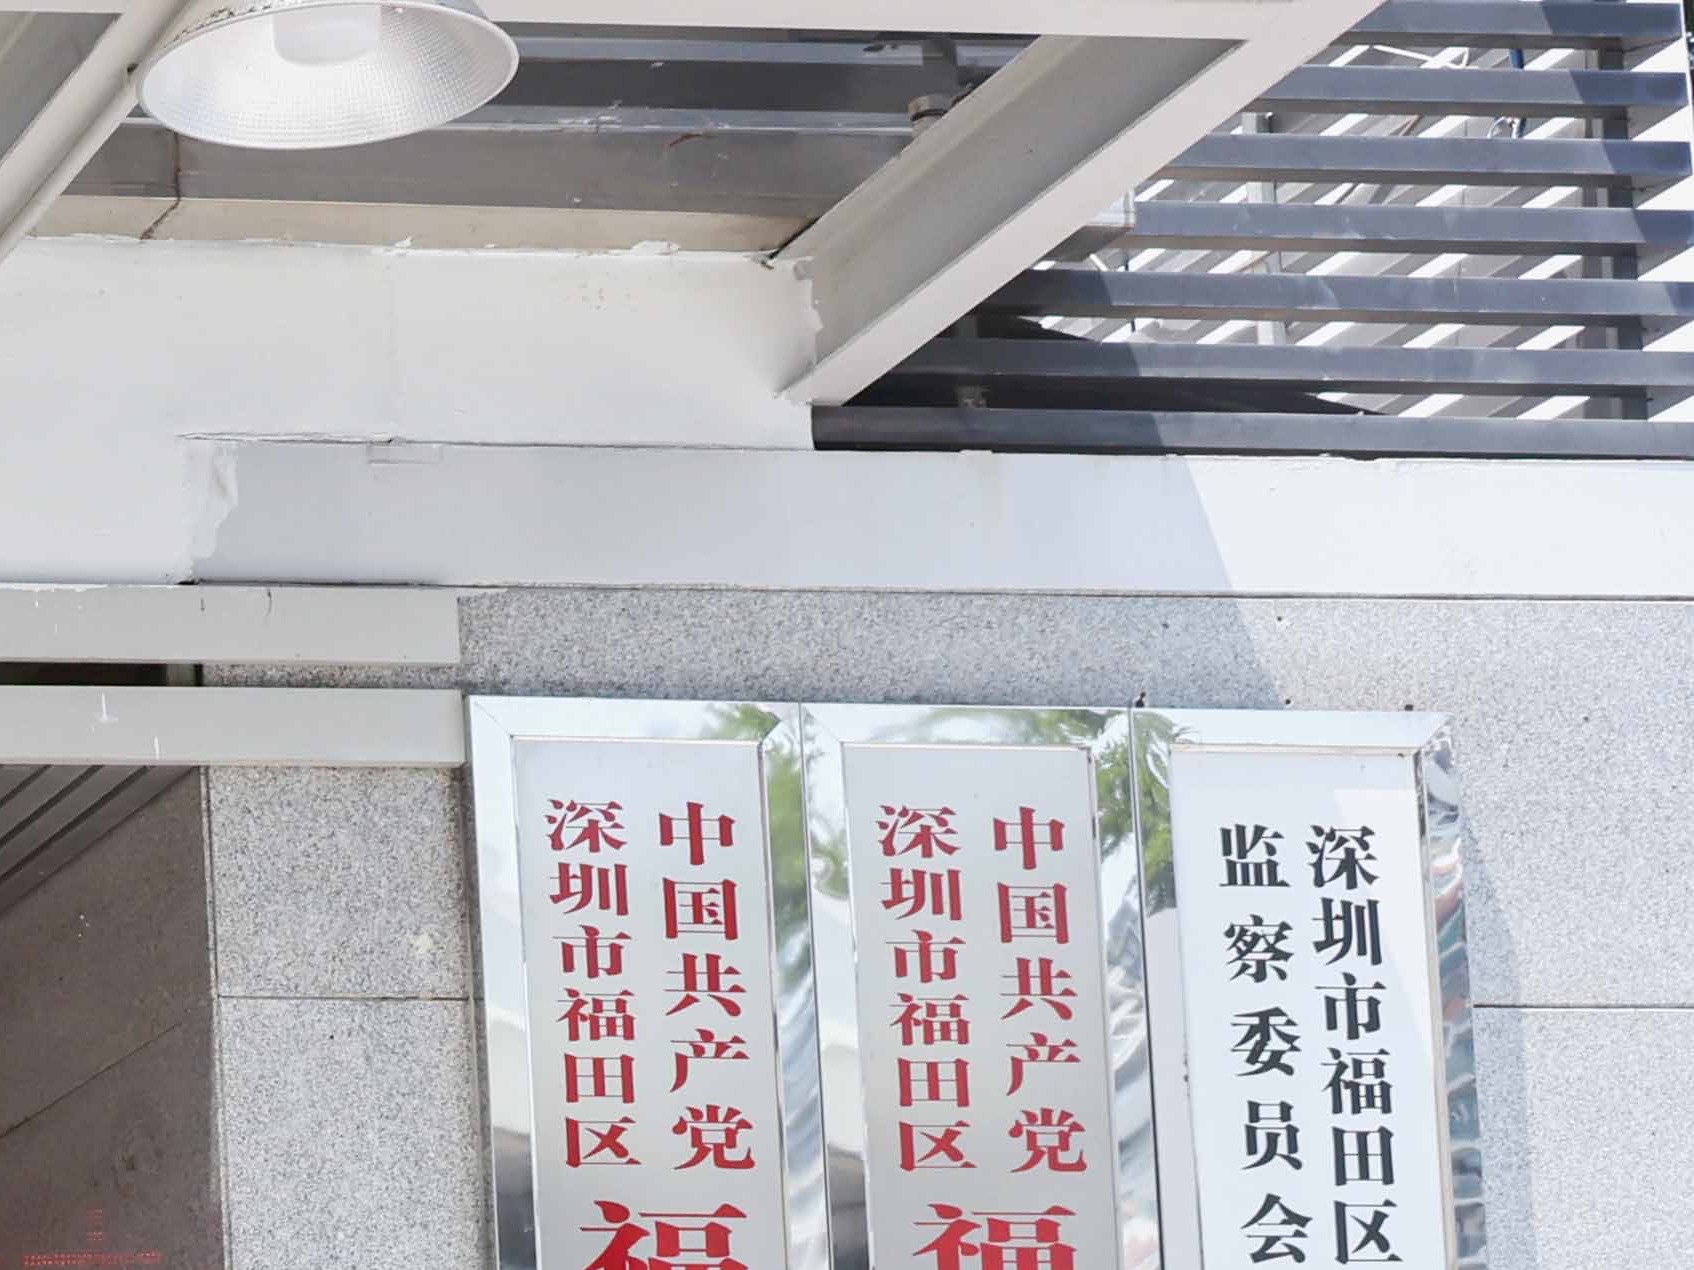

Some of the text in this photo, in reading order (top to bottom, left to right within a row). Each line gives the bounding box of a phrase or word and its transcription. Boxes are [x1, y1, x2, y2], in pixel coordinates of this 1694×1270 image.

[544, 799, 642, 1169] 深圳市福田区
[657, 803, 755, 1171] 中国共产党
[874, 804, 978, 1173] 深圳市福田区
[992, 806, 1087, 1173] 中国共产党
[1218, 823, 1313, 1265] 监察委员会
[1305, 824, 1402, 1266] 深圳市福田区
